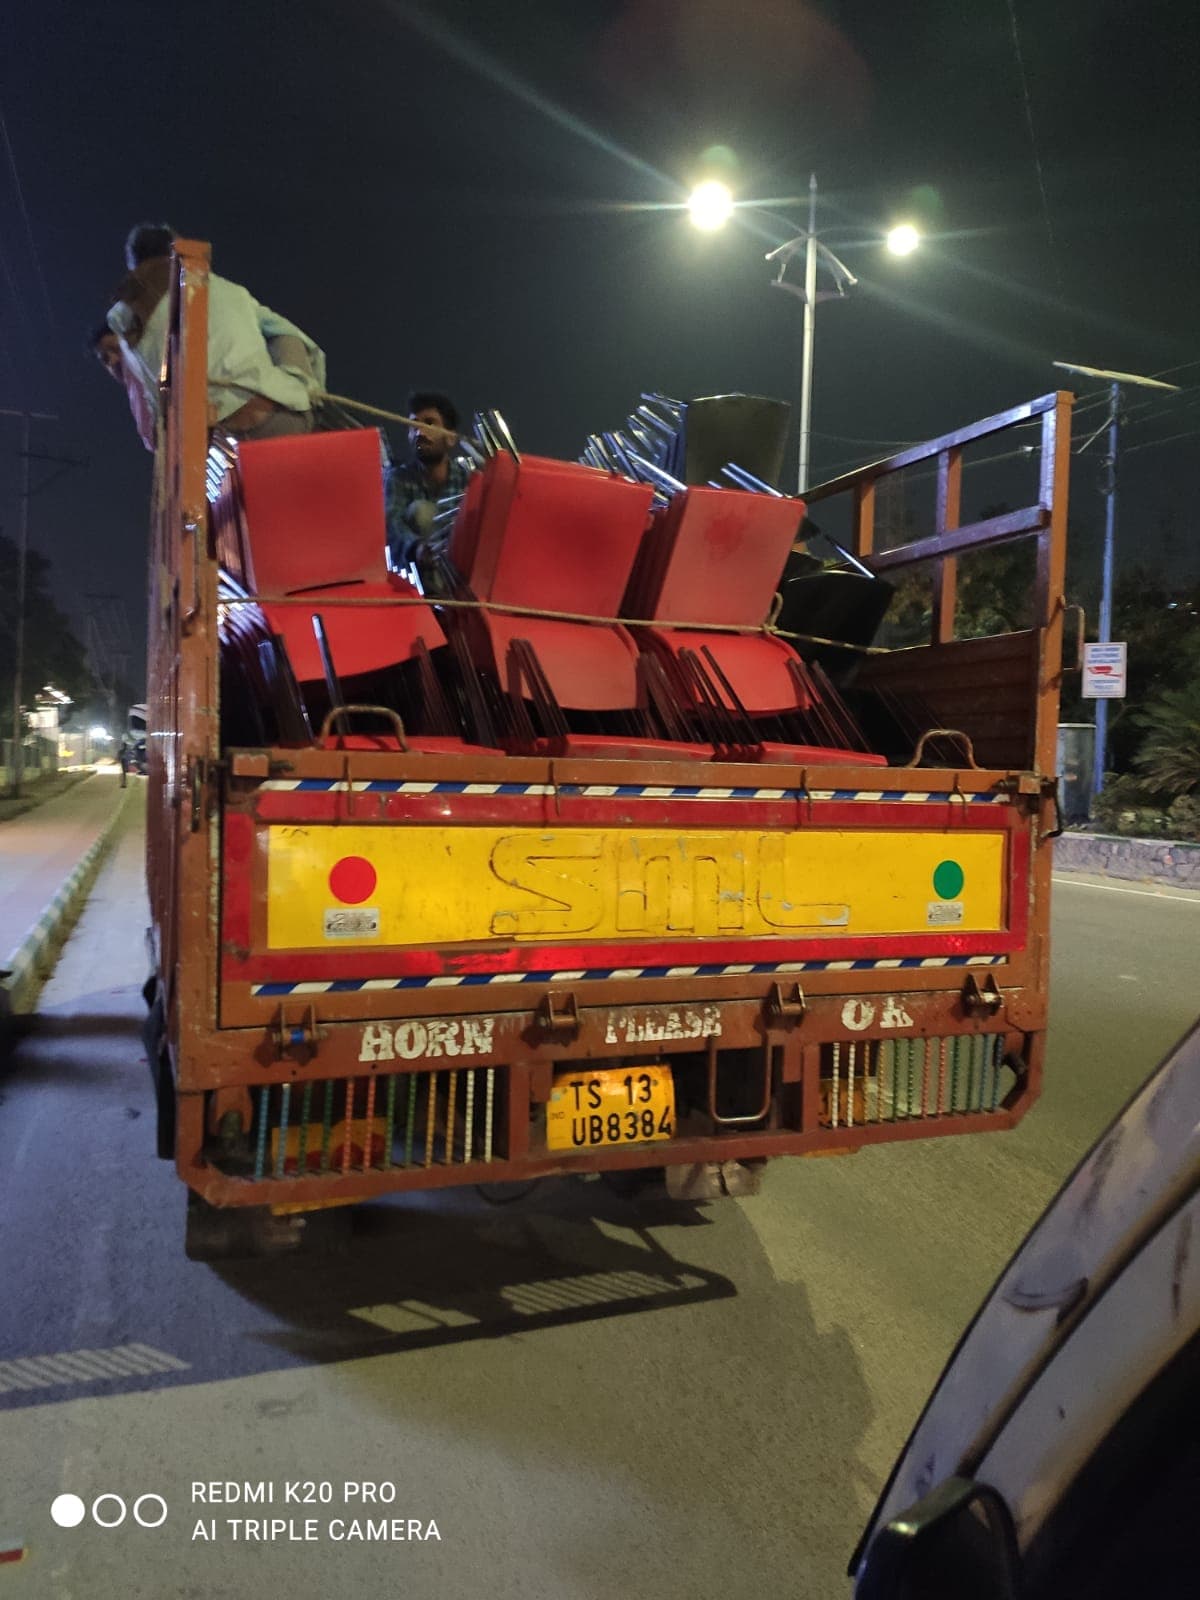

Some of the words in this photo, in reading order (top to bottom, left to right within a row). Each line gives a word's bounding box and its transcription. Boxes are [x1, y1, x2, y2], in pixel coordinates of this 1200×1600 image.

[359, 1018, 495, 1063] HORN
[605, 1006, 722, 1044] PLEASE
[570, 1080, 602, 1110] TS
[624, 1074, 652, 1105] 13
[572, 1105, 672, 1146] UB8384
